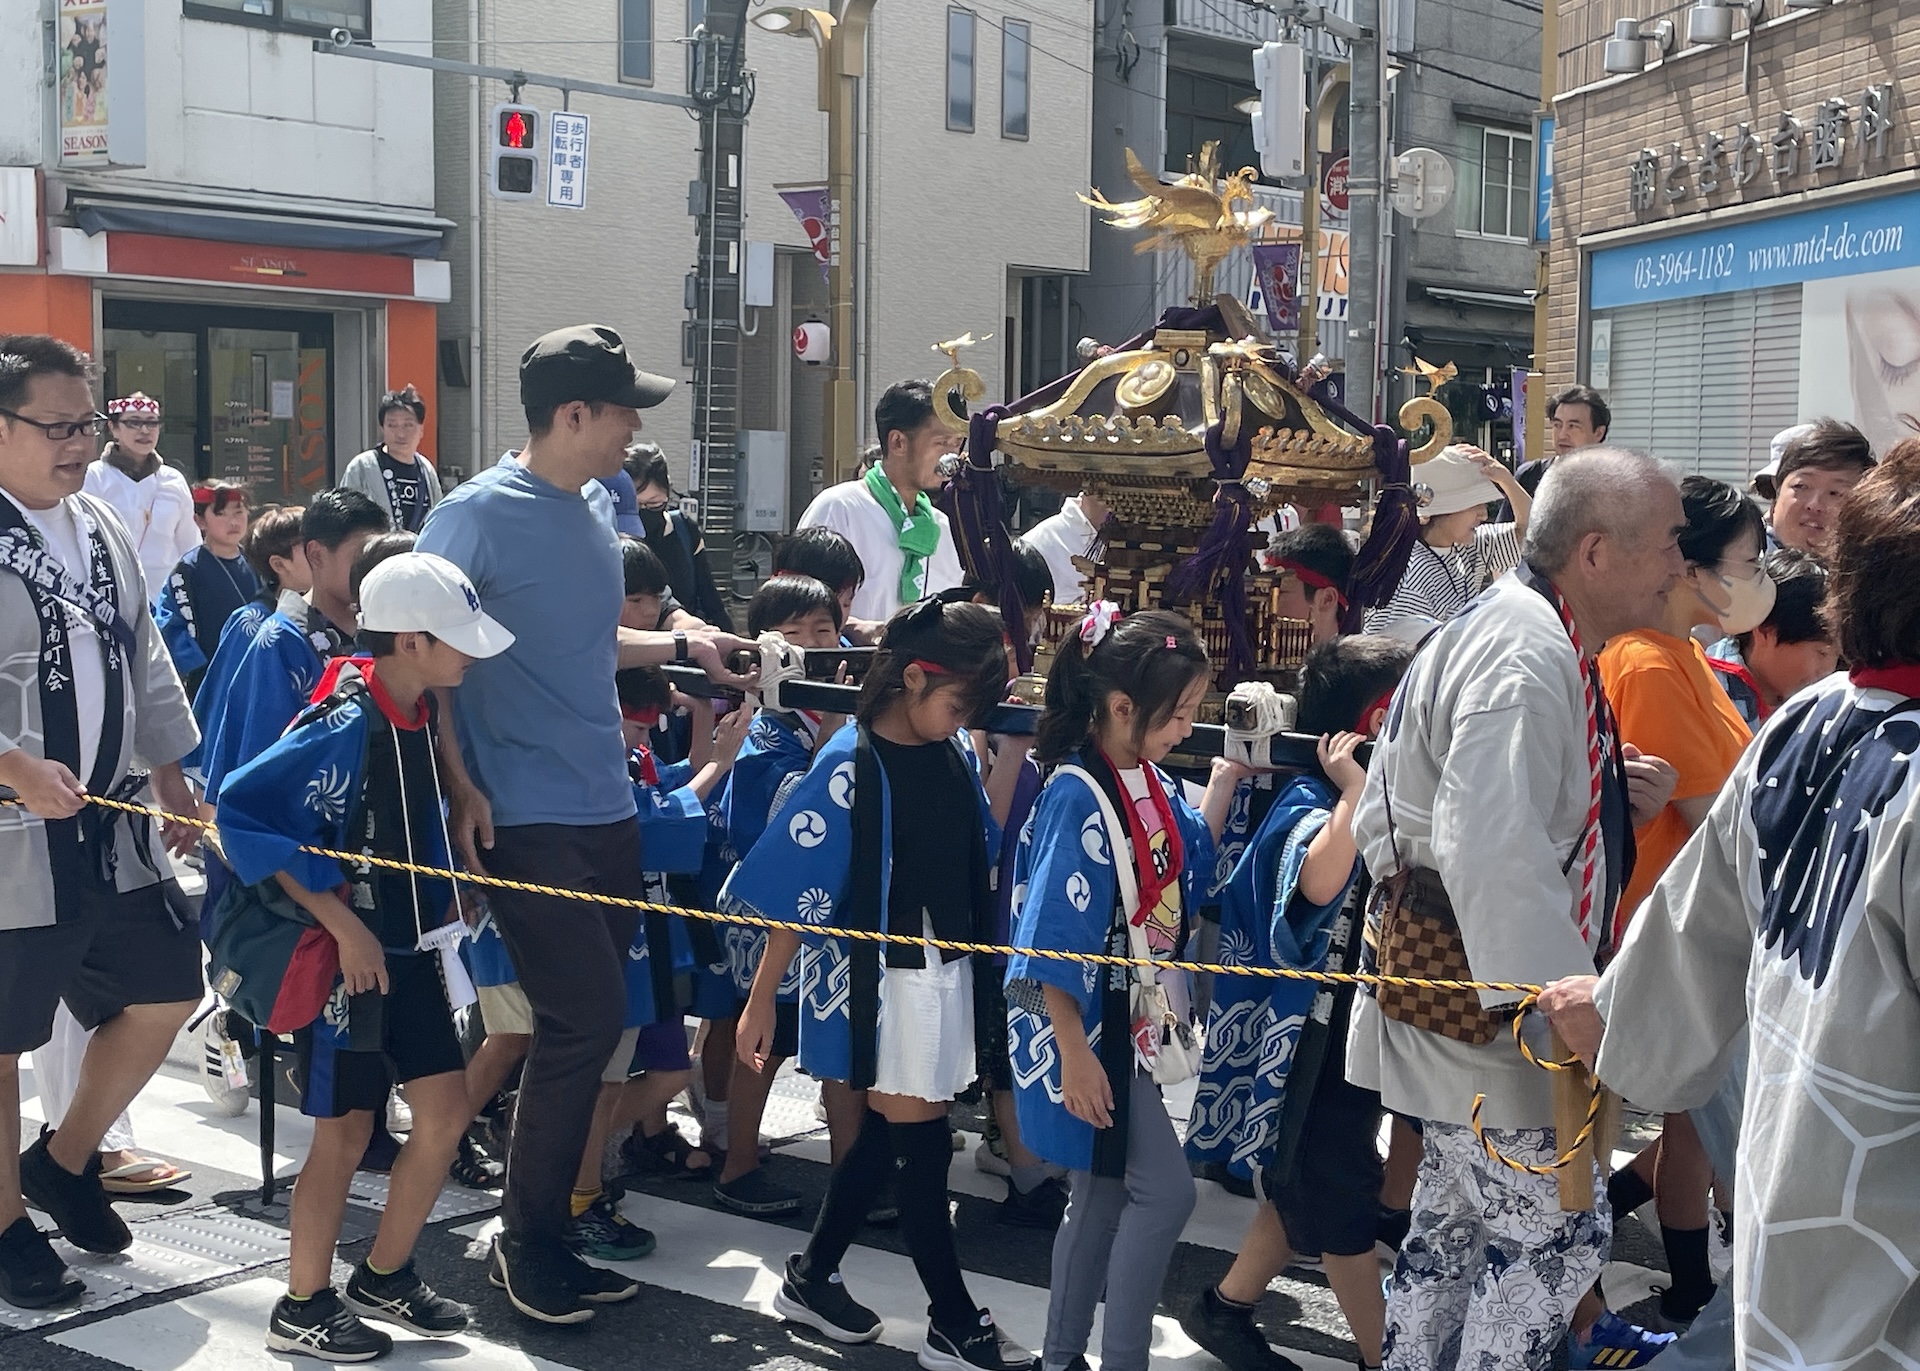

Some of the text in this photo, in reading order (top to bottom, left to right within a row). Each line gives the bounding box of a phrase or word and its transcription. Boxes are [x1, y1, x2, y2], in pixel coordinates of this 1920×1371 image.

[63, 134, 108, 151] SEASON
[553, 119, 569, 167] 自転車
[569, 122, 585, 169] 歩行者
[559, 169, 574, 201] 専用
[1634, 221, 1904, 290] 03-5964-1182 www.mtd-dc.com
